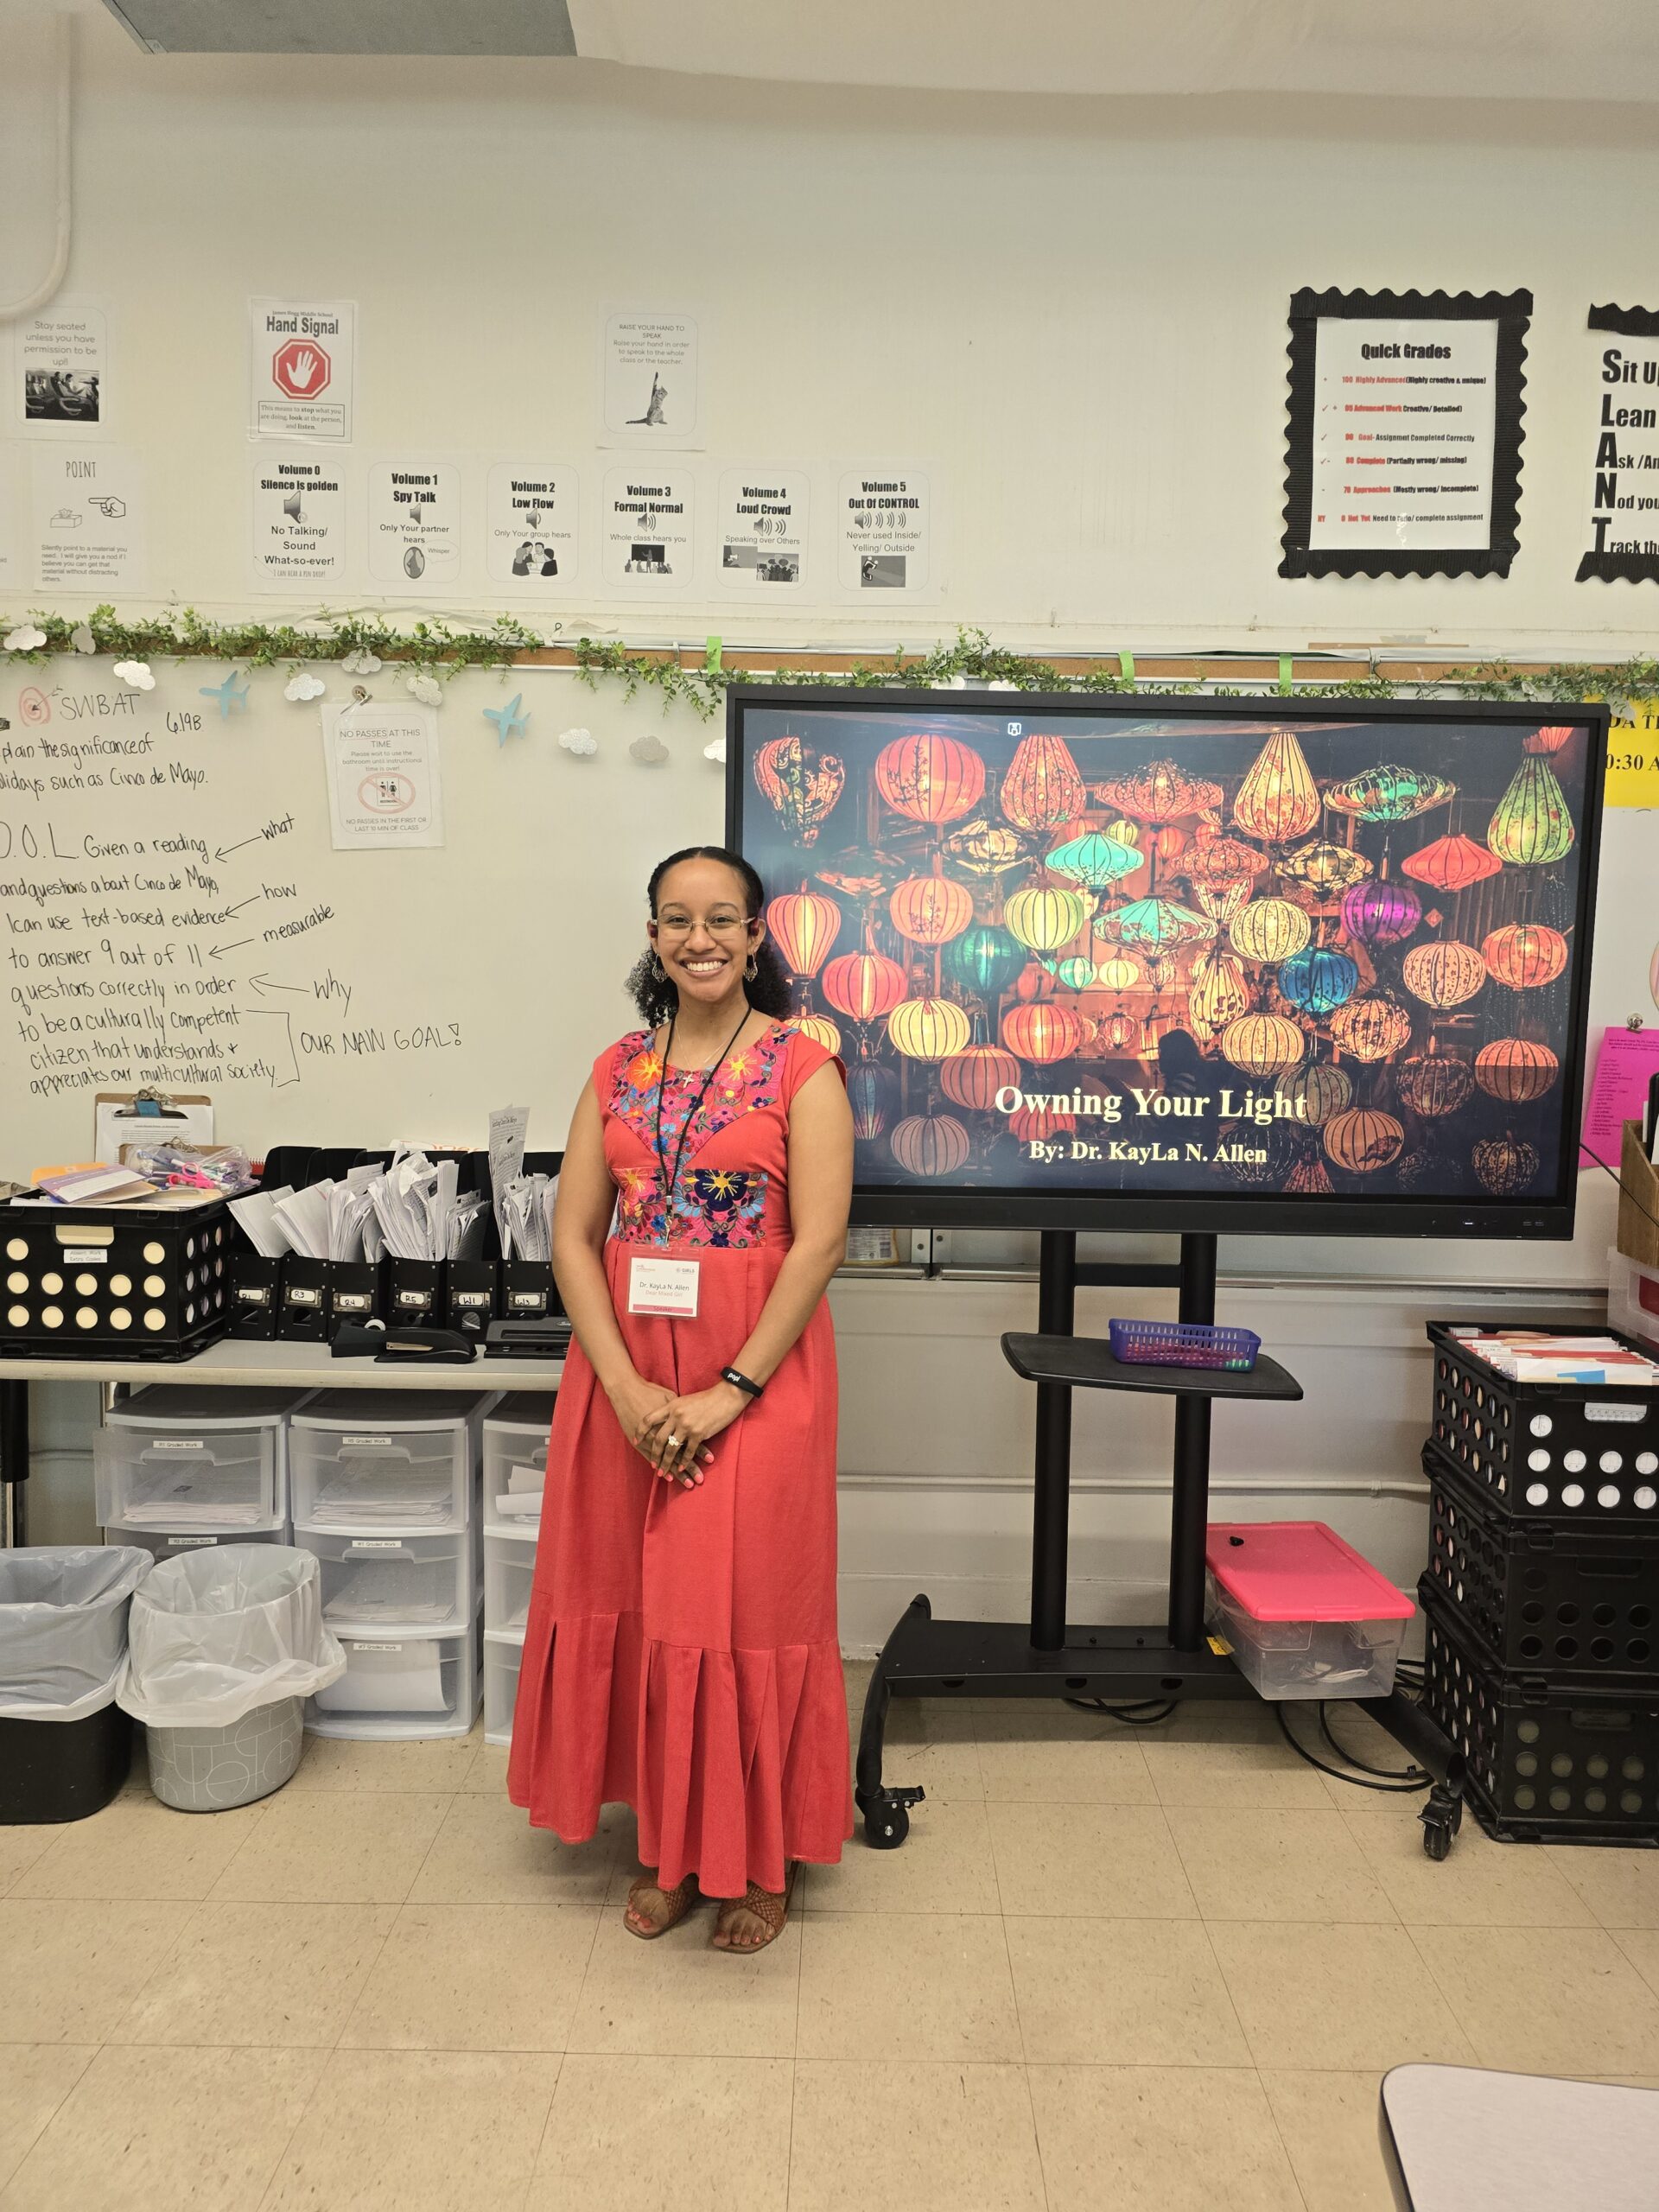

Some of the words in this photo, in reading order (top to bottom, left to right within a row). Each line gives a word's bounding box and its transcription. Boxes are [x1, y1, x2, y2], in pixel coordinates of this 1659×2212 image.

[35, 321, 54, 331] Stay
[266, 316, 297, 332] Hand
[302, 317, 339, 337] Signal
[1361, 344, 1401, 359] Quick
[1403, 344, 1451, 359] Grades
[1602, 349, 1638, 384] Sit
[1601, 394, 1657, 427] Lean
[1595, 432, 1634, 468] Ask
[66, 461, 96, 477] POINT
[278, 465, 313, 475] Volume
[315, 465, 320, 475] 0
[261, 480, 294, 490] Silence
[297, 480, 304, 490] is
[307, 480, 339, 491] golden
[391, 474, 430, 485] Volume
[432, 474, 437, 486] 1
[512, 481, 548, 493] Volume
[550, 482, 555, 493] 2
[861, 481, 899, 493] Volume
[900, 481, 906, 493] 5
[394, 491, 413, 503] Spy
[414, 492, 436, 503] Talk
[627, 486, 663, 497] Volume
[665, 486, 671, 497] 3
[743, 486, 779, 498] Volume
[780, 488, 786, 499] 4
[1594, 473, 1634, 509] Nod
[512, 498, 531, 508] Low
[532, 498, 555, 509] Flow
[615, 501, 647, 512] Formal
[649, 502, 683, 513] Normal
[736, 503, 759, 513] Loud
[760, 504, 791, 515] Crowd
[849, 498, 866, 508] Out
[867, 498, 876, 508] Of
[878, 498, 919, 508] CONTROL
[271, 525, 285, 535] No
[289, 526, 328, 537] Talking/
[380, 524, 398, 532] Only
[494, 529, 510, 537] Only
[873, 531, 893, 539] used
[895, 531, 921, 539] Inside/
[1592, 517, 1640, 553] Track
[283, 541, 316, 550] Sound
[653, 534, 672, 543] hears
[726, 536, 758, 544] Speaking
[853, 543, 881, 553] Yelling/
[884, 543, 915, 552] Outside
[264, 555, 334, 565] What-so-ever!
[60, 693, 140, 721] SWBAT
[356, 729, 387, 738] PASSES
[138, 733, 154, 753] of
[50, 773, 85, 791] such
[88, 774, 104, 786] as
[150, 767, 166, 785] de
[261, 813, 295, 840] what
[85, 835, 129, 858] Given
[134, 840, 145, 854] a
[152, 833, 209, 864] reading
[0, 878, 28, 897] and
[28, 878, 87, 907] questions
[92, 874, 130, 893] about
[135, 873, 166, 891] Cinco
[169, 873, 181, 890] de
[261, 883, 297, 900] how
[14, 918, 42, 933] can
[48, 916, 73, 931] use
[81, 907, 165, 928] text-based
[173, 907, 226, 927] evidence
[263, 904, 335, 943] measurable
[9, 948, 29, 969] to
[38, 950, 92, 968] answer
[101, 939, 115, 965] 9
[120, 944, 147, 965] out
[154, 944, 176, 966] of
[11, 976, 95, 1016] questions
[99, 978, 165, 1007] correctly
[175, 980, 190, 995] in
[195, 976, 237, 995] order
[17, 1020, 40, 1042] to
[41, 1013, 67, 1033] be
[71, 1016, 83, 1032] a
[86, 1006, 167, 1044] culturally
[170, 1004, 242, 1035] competent
[301, 1032, 335, 1054] OUR
[30, 1044, 90, 1071] citizen
[92, 1037, 130, 1058] that
[134, 1038, 225, 1060] understands
[29, 1066, 109, 1097] appreciates
[111, 1067, 131, 1082] our
[140, 1063, 223, 1085] multicultural
[995, 1086, 1122, 1123] Owning
[1132, 1088, 1211, 1117] Your
[1218, 1090, 1308, 1125] Light
[1029, 1141, 1065, 1164] By:
[1071, 1141, 1103, 1160] Dr.
[1110, 1142, 1179, 1166] KayLa
[1185, 1144, 1209, 1162] N.
[1216, 1144, 1268, 1163] Allen
